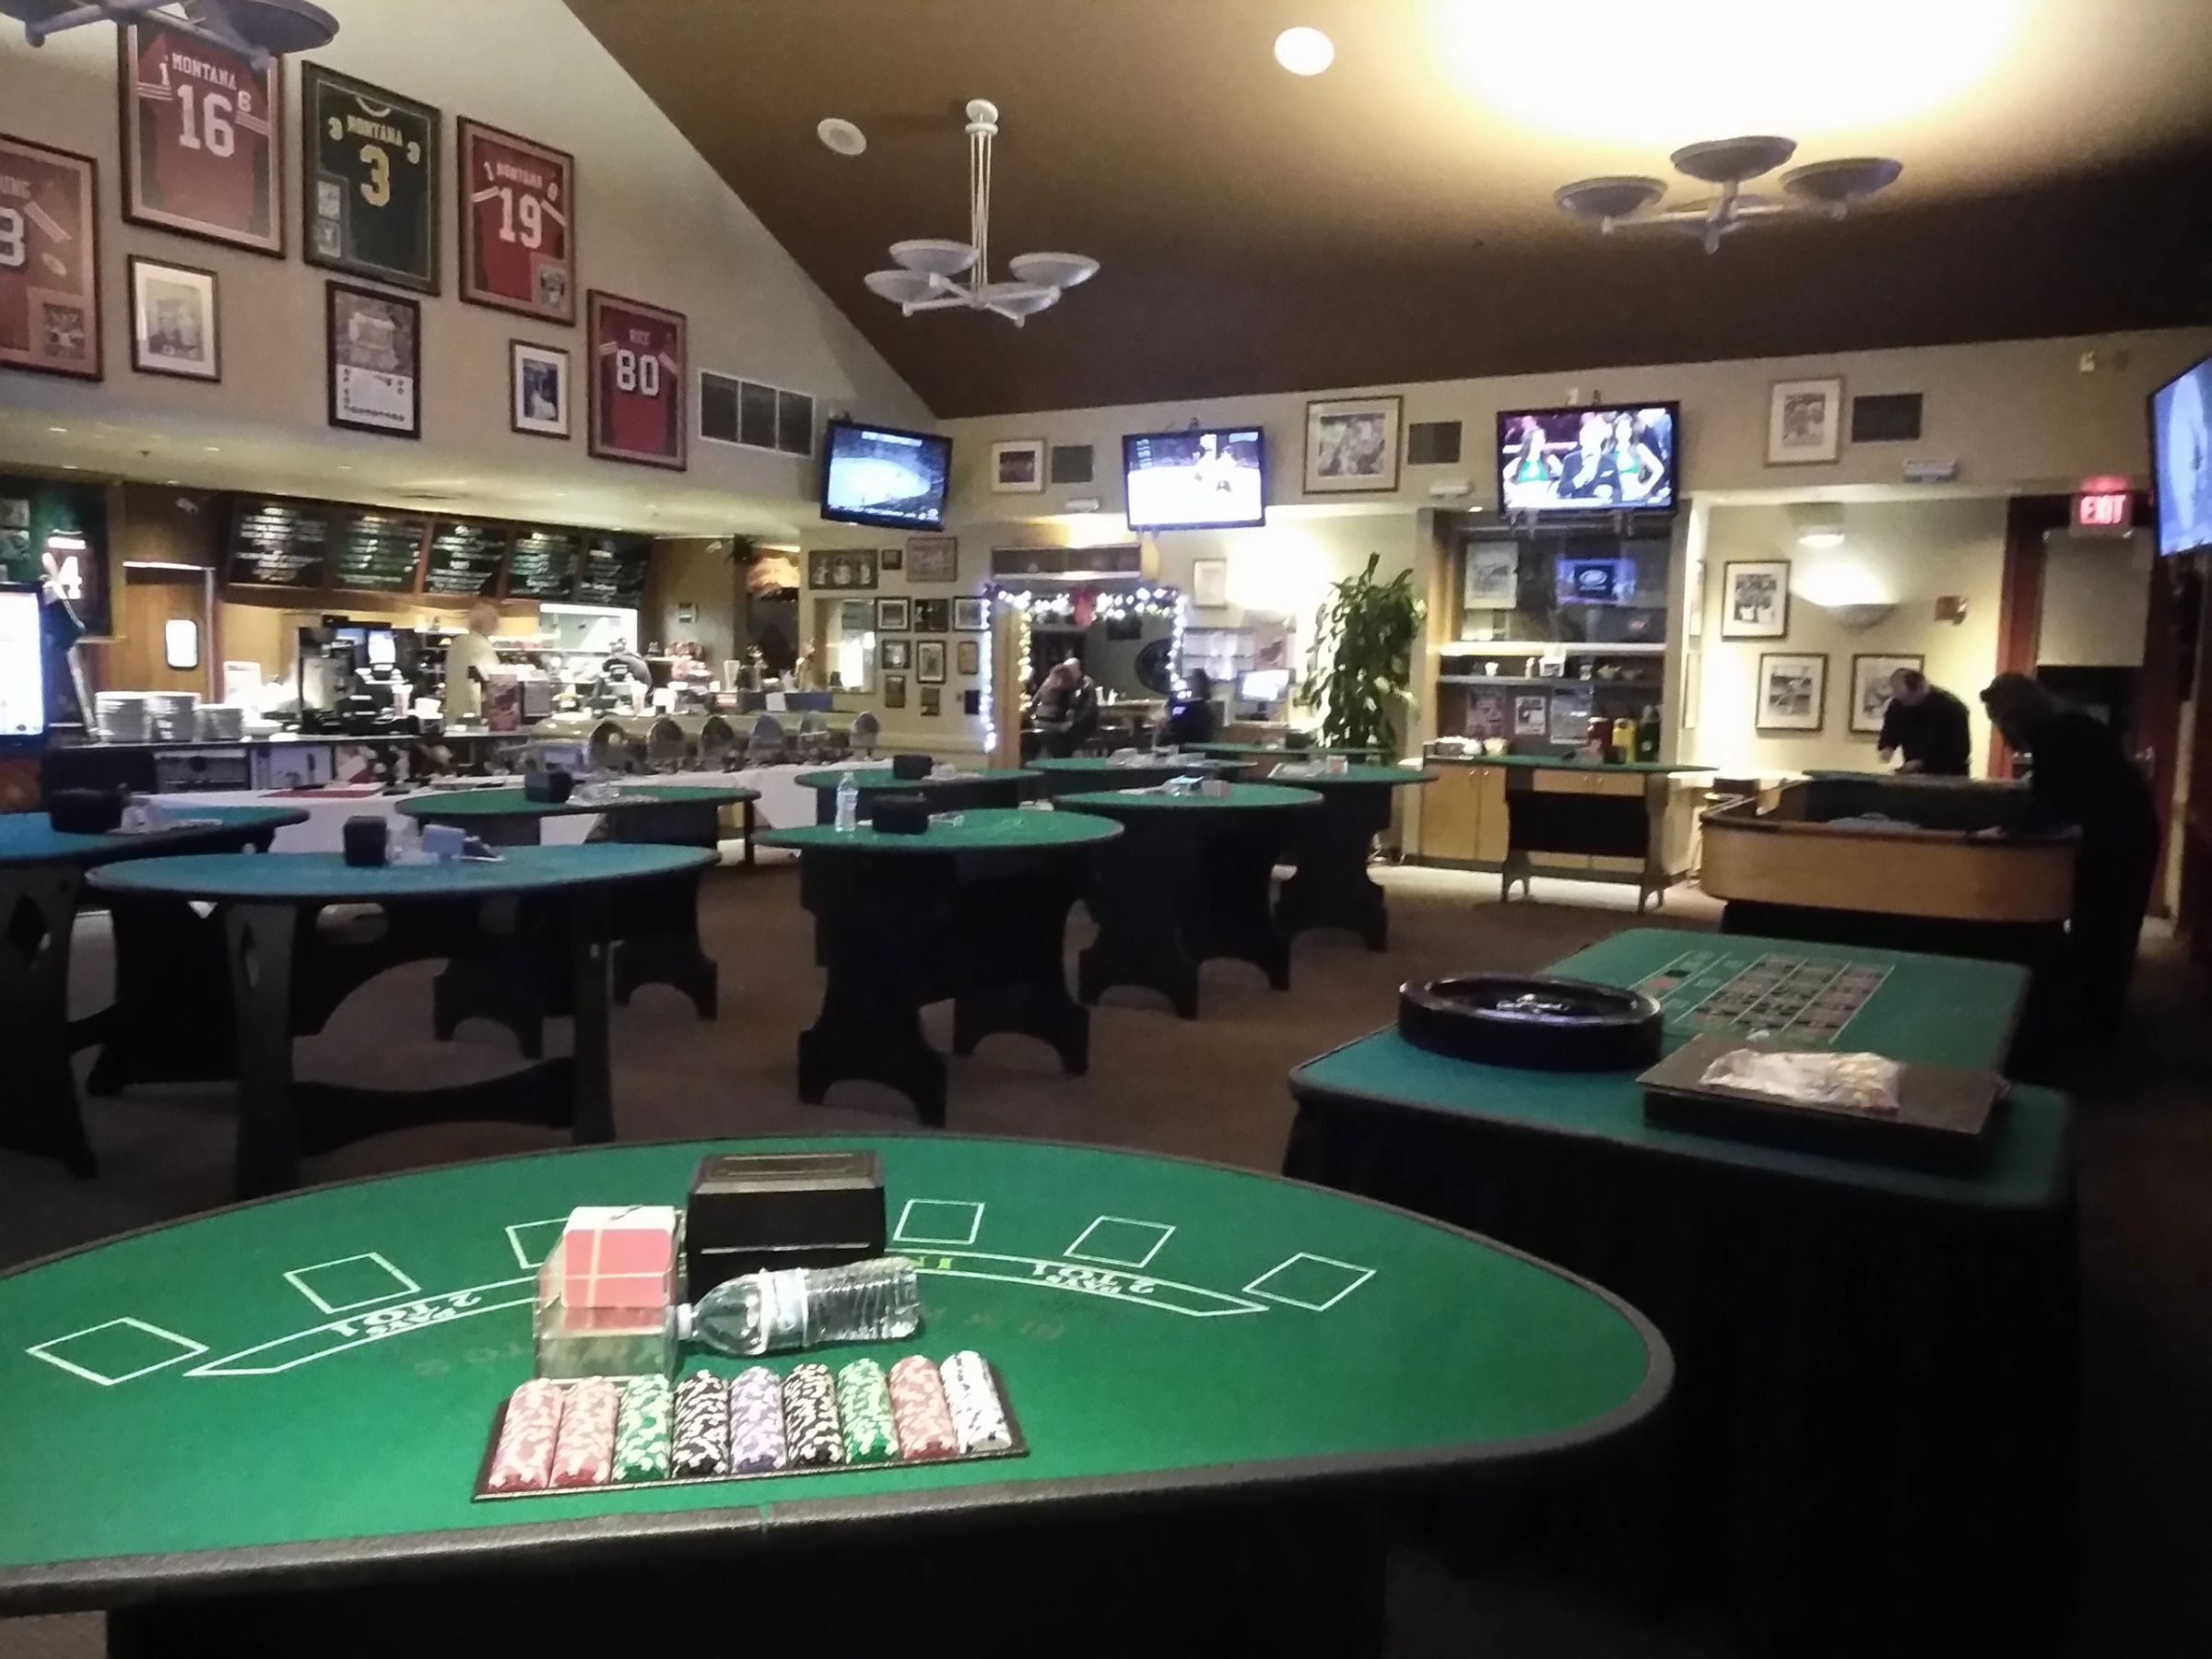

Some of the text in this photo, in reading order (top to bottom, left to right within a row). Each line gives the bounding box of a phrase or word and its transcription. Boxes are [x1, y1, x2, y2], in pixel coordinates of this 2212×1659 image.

[171, 53, 237, 91] MONTANA
[177, 84, 234, 158] 16
[328, 116, 343, 141] 3
[359, 144, 391, 206] 3
[406, 141, 421, 165] 3
[499, 187, 543, 249] 19
[617, 348, 659, 396] 80
[2079, 494, 2126, 525] EXIT
[59, 556, 83, 600] 4
[1032, 1263, 1156, 1294] 2 TO 1
[329, 1292, 482, 1337] 2 TO 1
